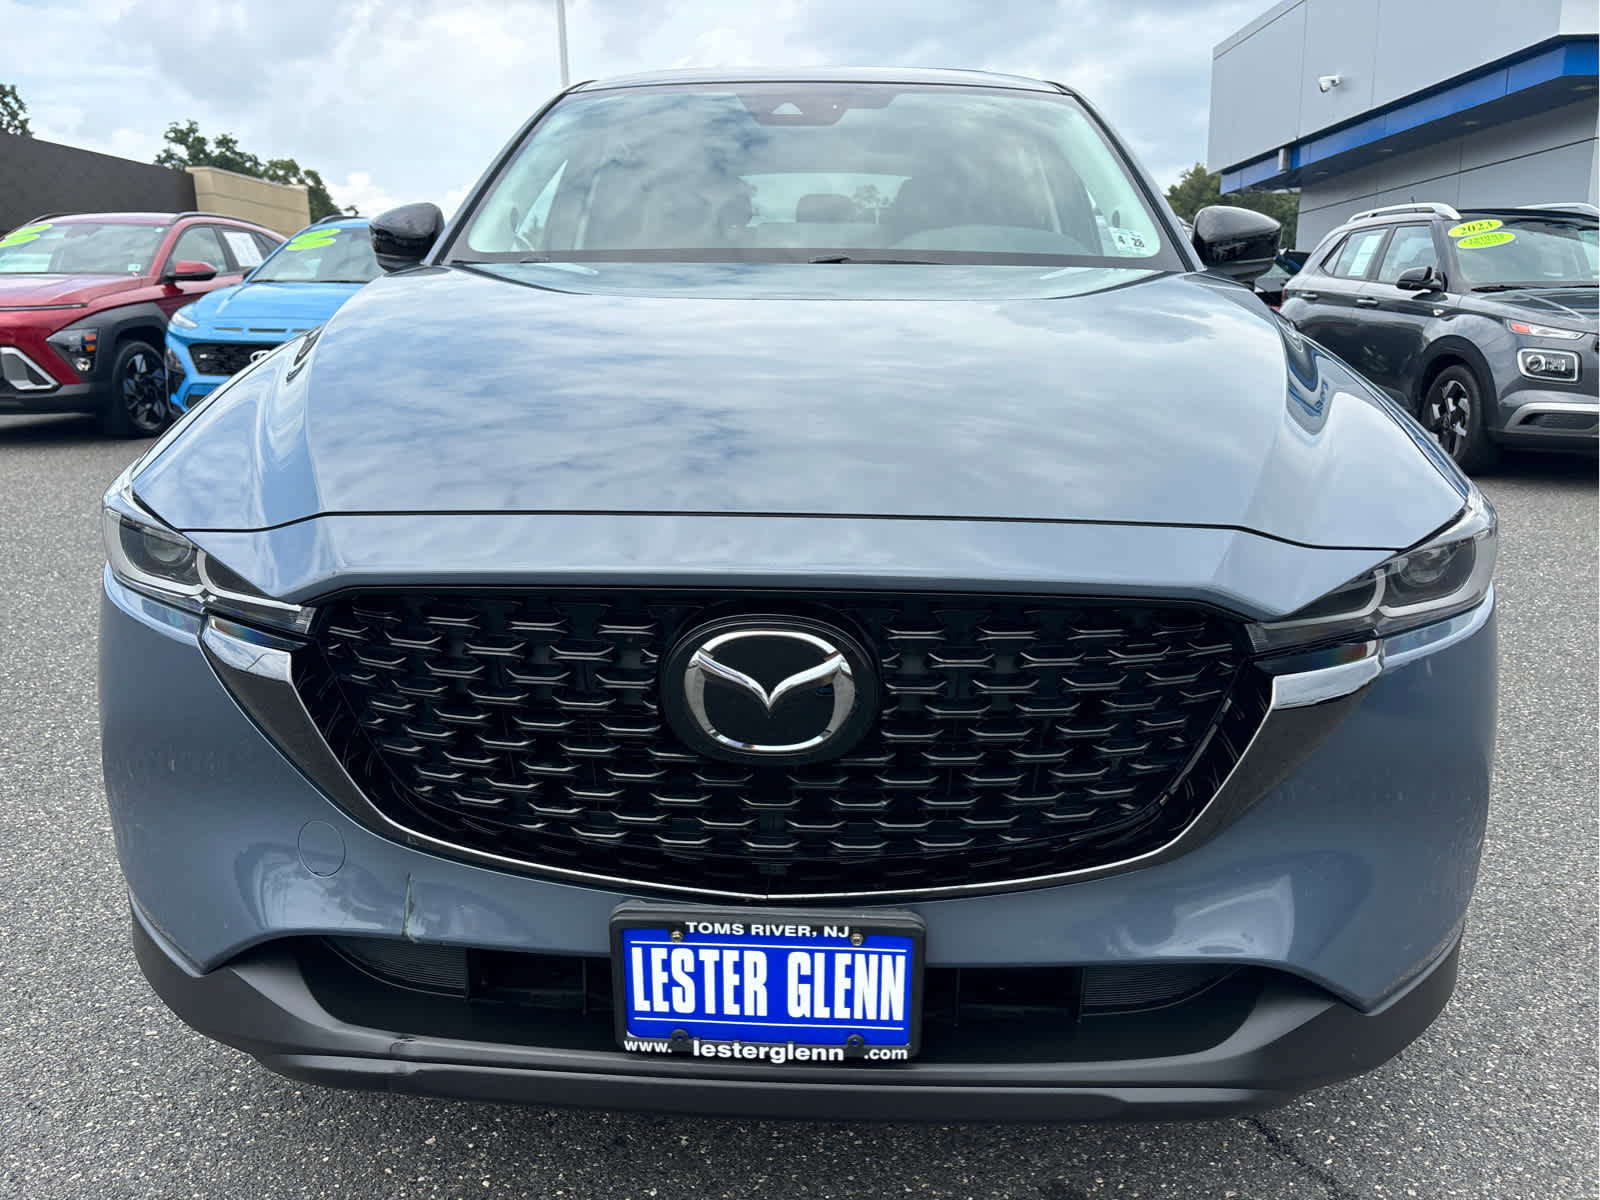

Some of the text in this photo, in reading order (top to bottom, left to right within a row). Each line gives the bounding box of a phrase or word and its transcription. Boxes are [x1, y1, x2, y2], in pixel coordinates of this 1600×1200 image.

[1460, 220, 1493, 235] 2023
[685, 921, 850, 938] TOMS RIVER, NJ
[630, 946, 906, 1021] LESTER GLENN
[623, 1039, 908, 1064] www. lesterglenn .com
